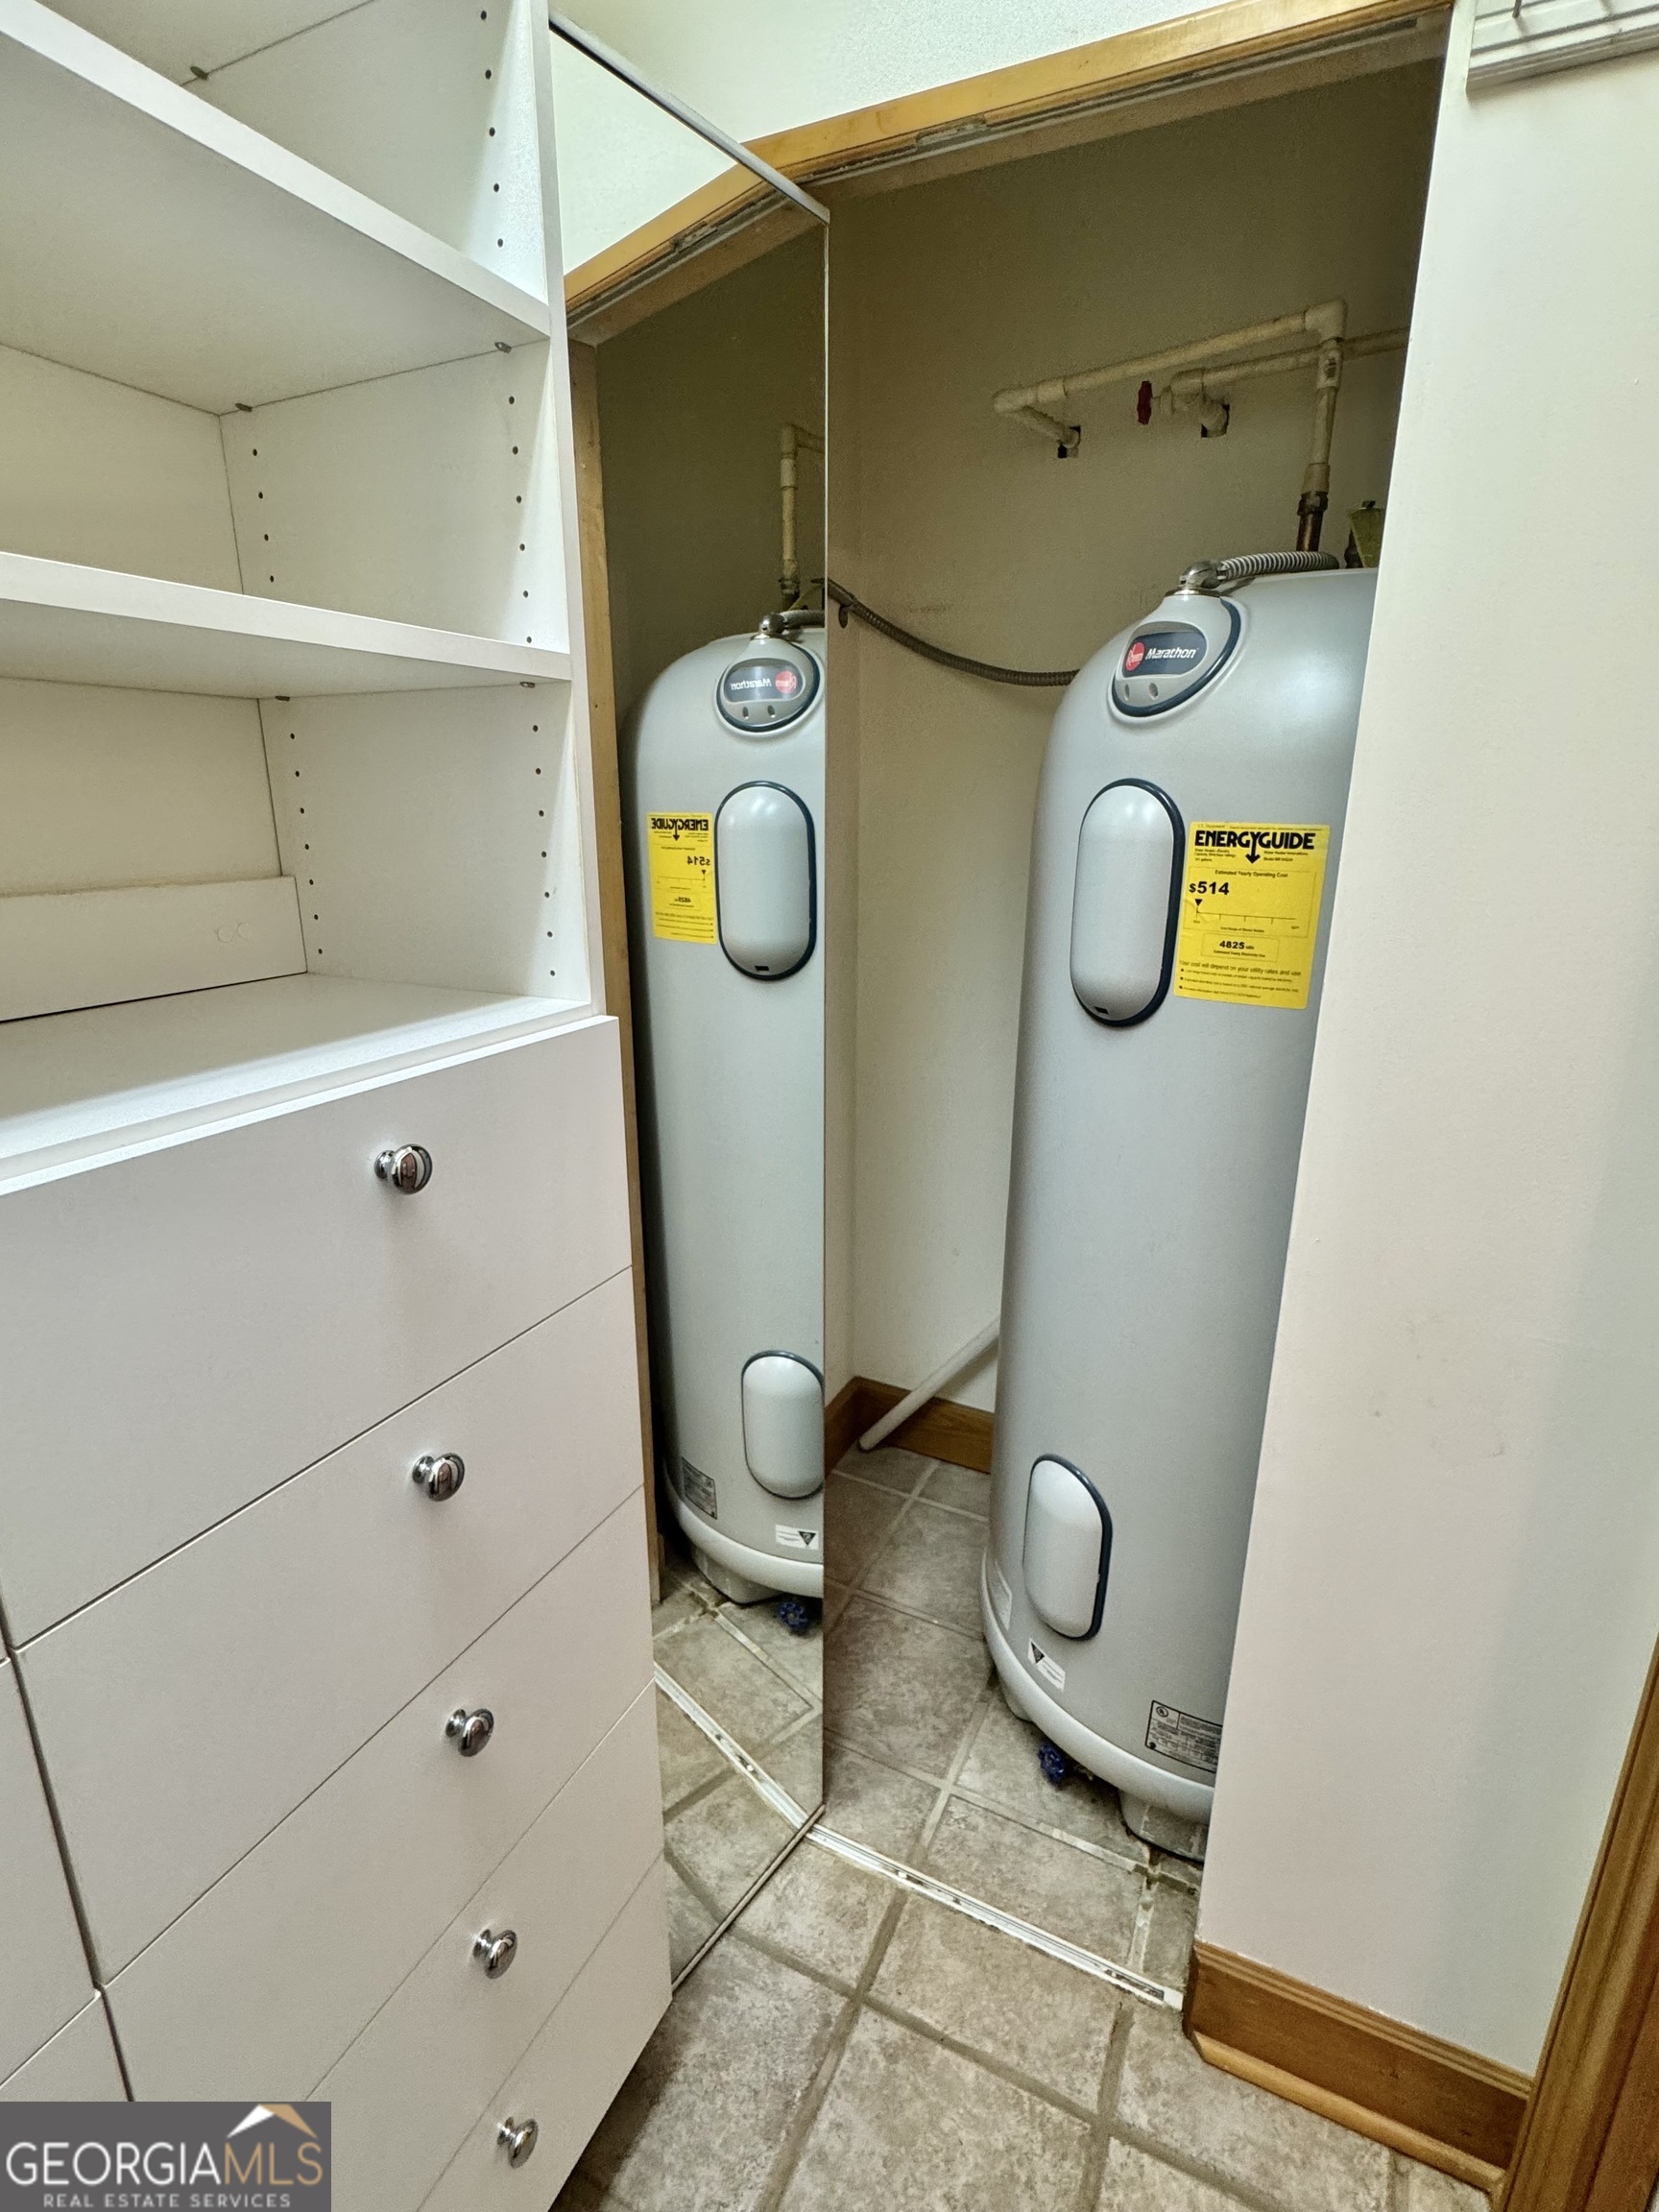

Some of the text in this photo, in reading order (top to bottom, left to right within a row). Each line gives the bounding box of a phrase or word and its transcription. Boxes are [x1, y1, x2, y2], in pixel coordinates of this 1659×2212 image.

[1144, 647, 1196, 660] Marathon
[1194, 830, 1315, 850] ENERGYGUIDE
[1189, 880, 1230, 896] $514
[1219, 940, 1245, 950] 4825
